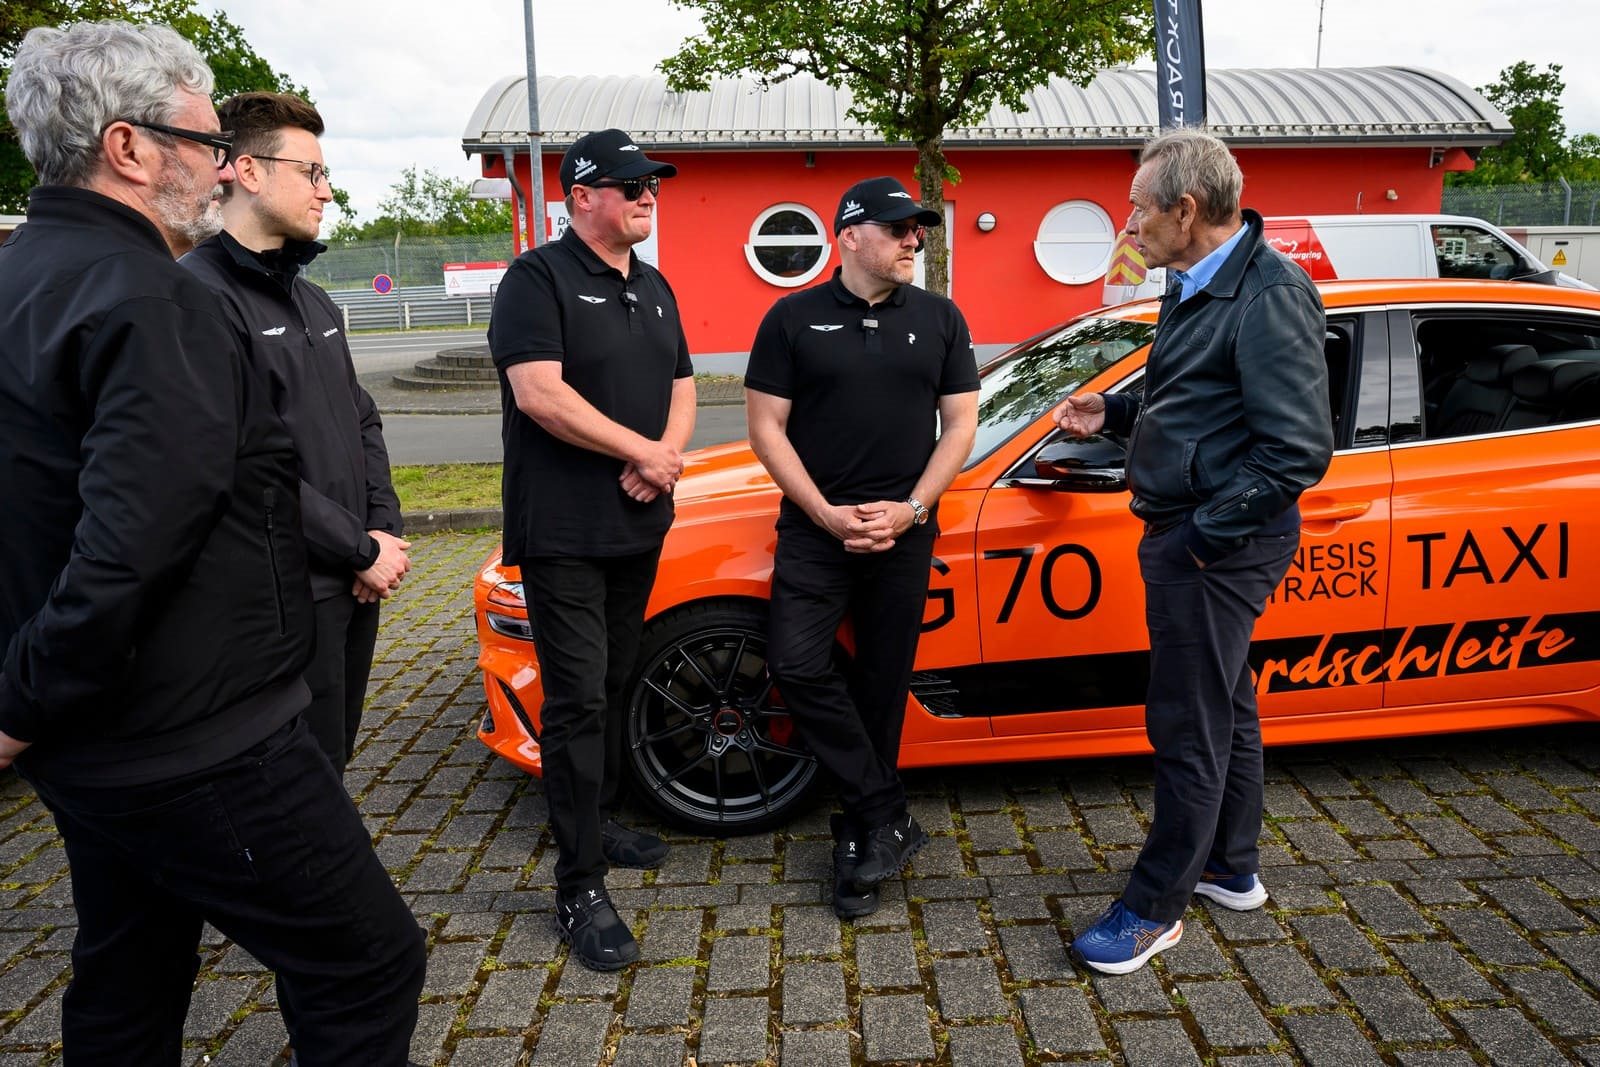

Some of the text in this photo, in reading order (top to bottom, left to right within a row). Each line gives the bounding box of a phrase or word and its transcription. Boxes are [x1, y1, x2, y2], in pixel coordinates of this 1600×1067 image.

[984, 543, 1102, 620] 70
[1407, 522, 1569, 590] TAXI
[1250, 614, 1575, 695] rdschleife
